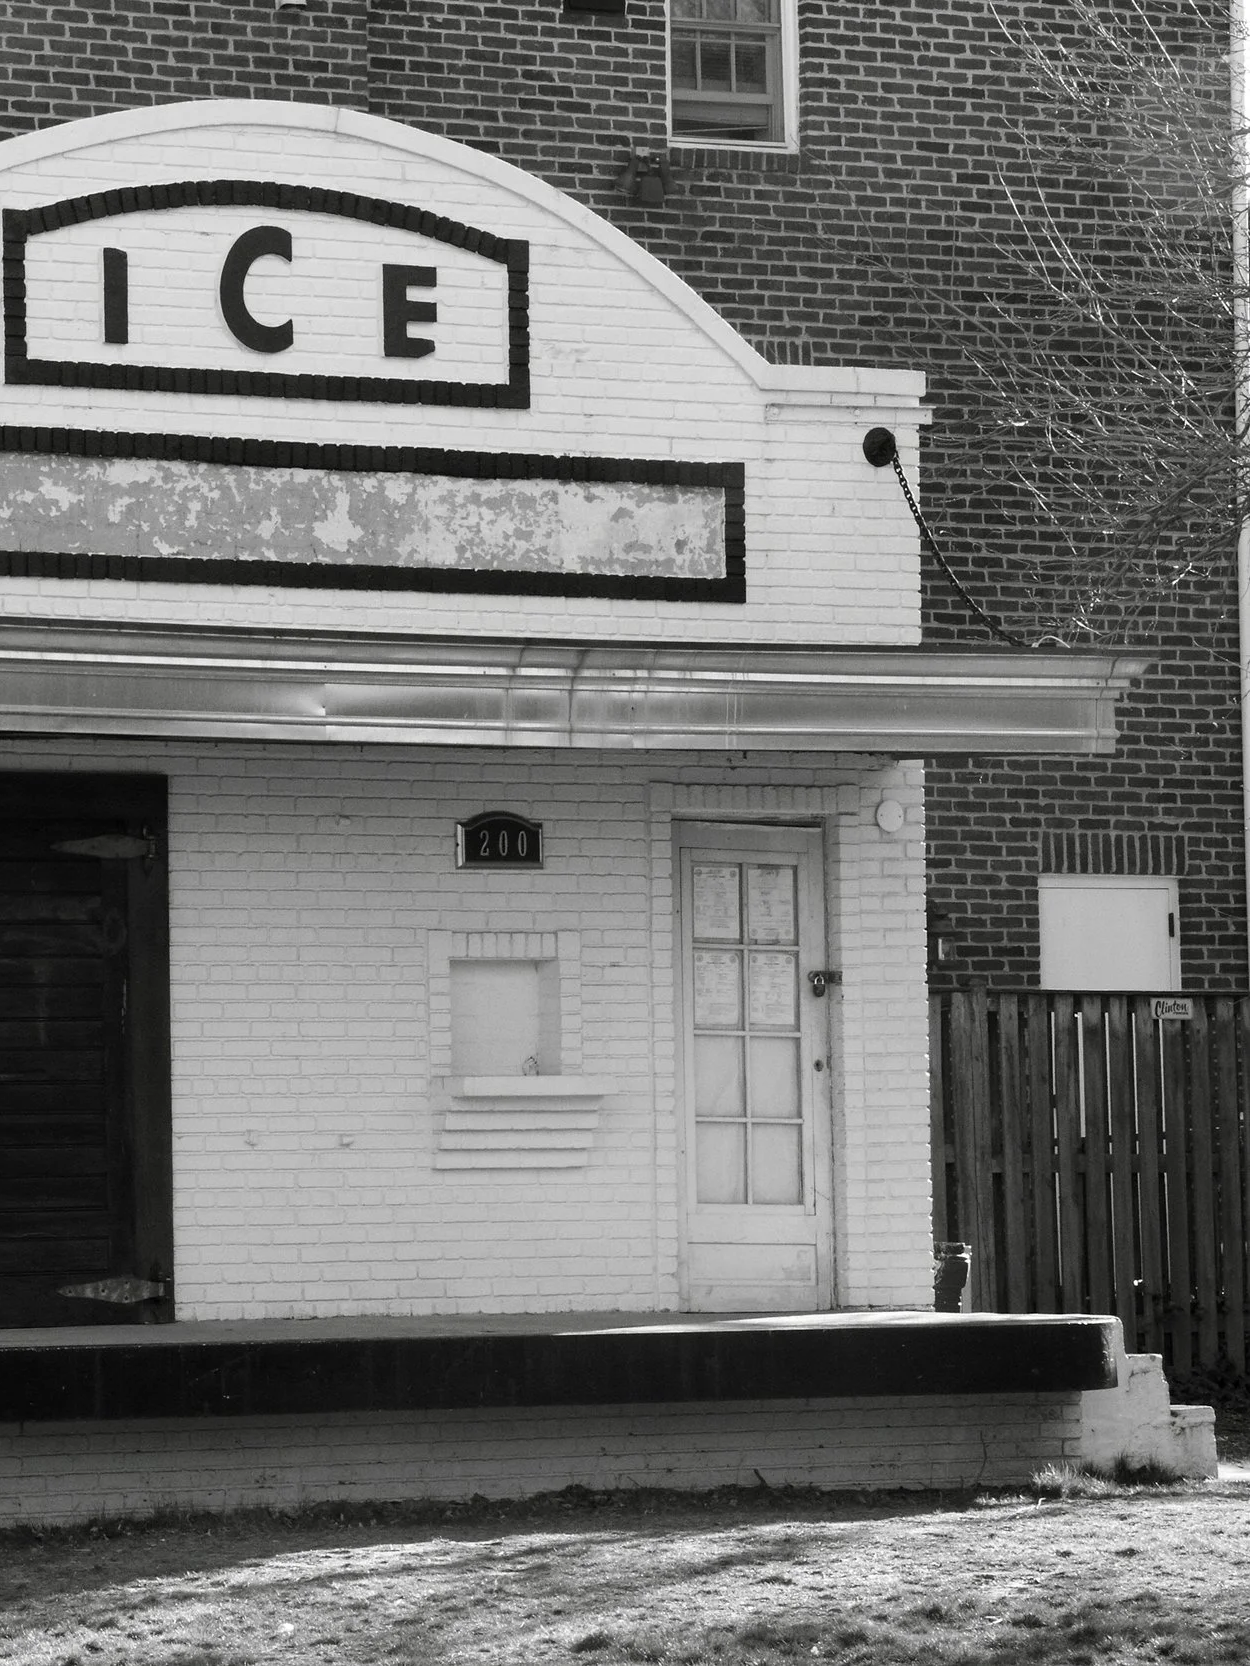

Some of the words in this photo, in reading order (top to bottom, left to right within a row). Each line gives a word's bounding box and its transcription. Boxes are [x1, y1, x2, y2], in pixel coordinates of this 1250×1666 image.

[103, 226, 437, 358] ICE
[480, 830, 527, 857] 200
[1154, 1000, 1187, 1018] Clinton
